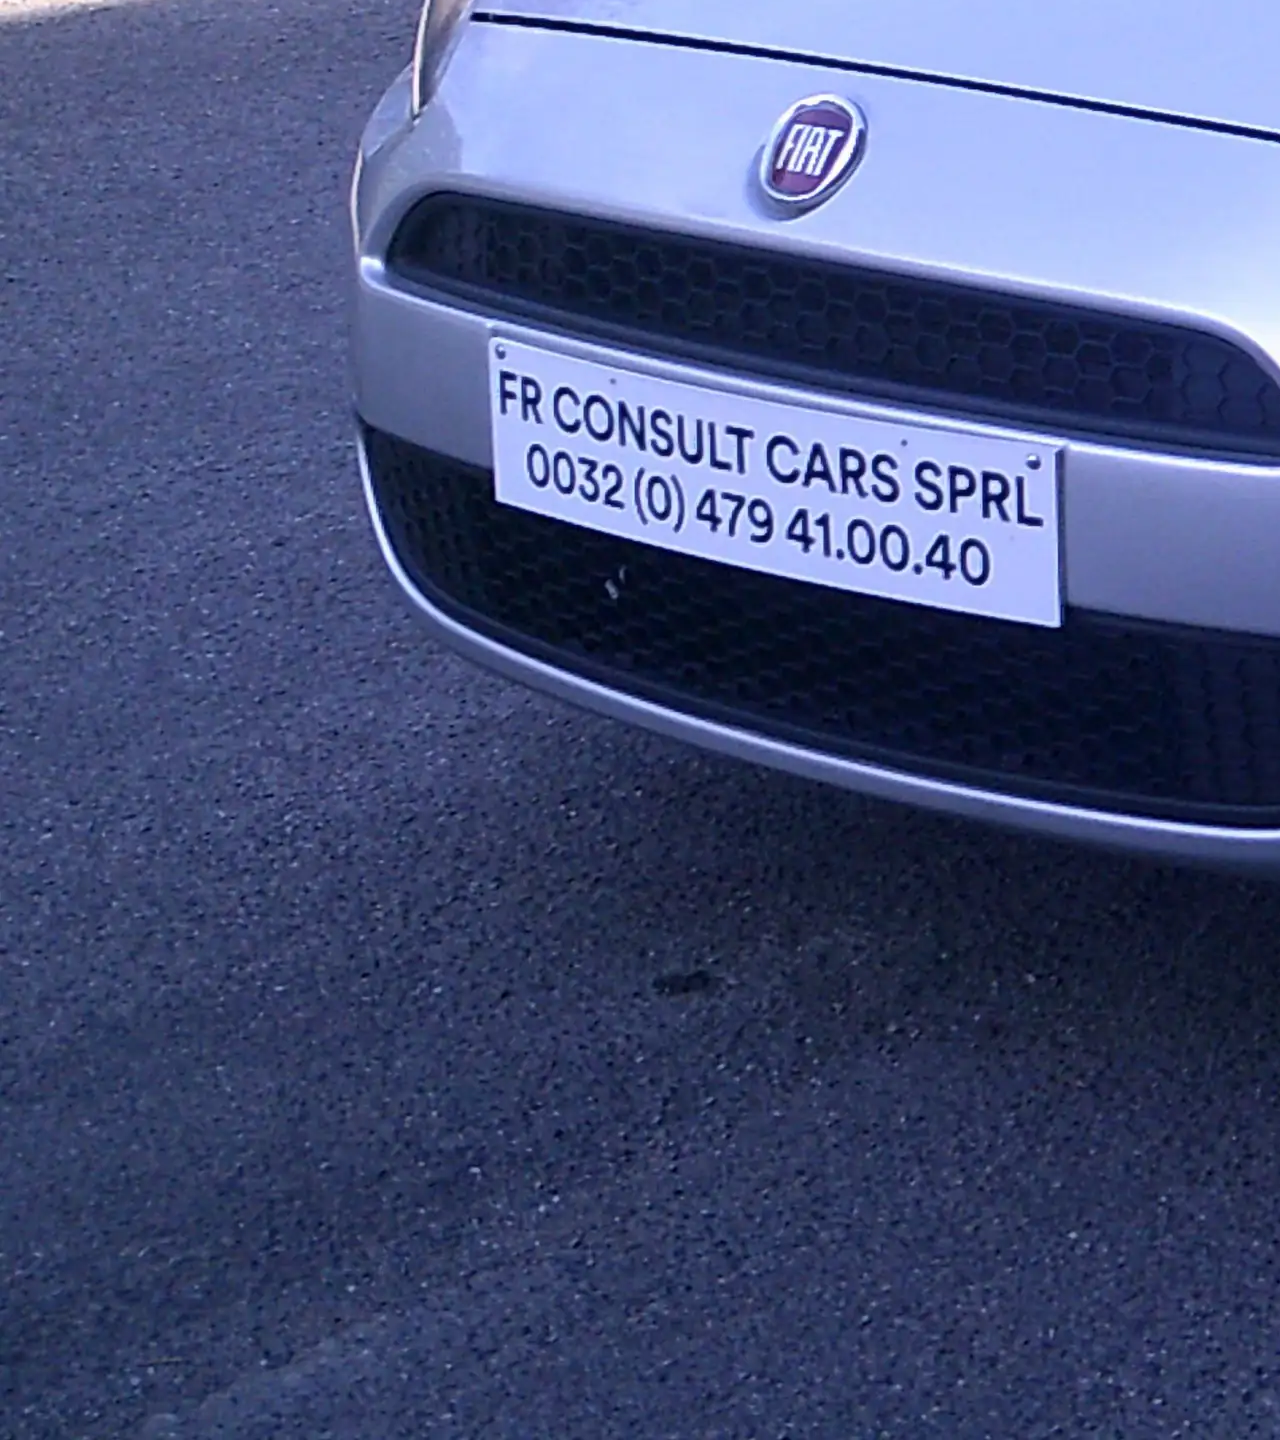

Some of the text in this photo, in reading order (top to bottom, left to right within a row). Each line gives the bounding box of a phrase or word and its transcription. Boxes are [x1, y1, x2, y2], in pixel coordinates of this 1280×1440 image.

[776, 123, 845, 176] FIAT
[498, 370, 1044, 527] FR CONSULT CARS SPRL
[526, 444, 991, 586] 0032 (0) 479 41.00.40
